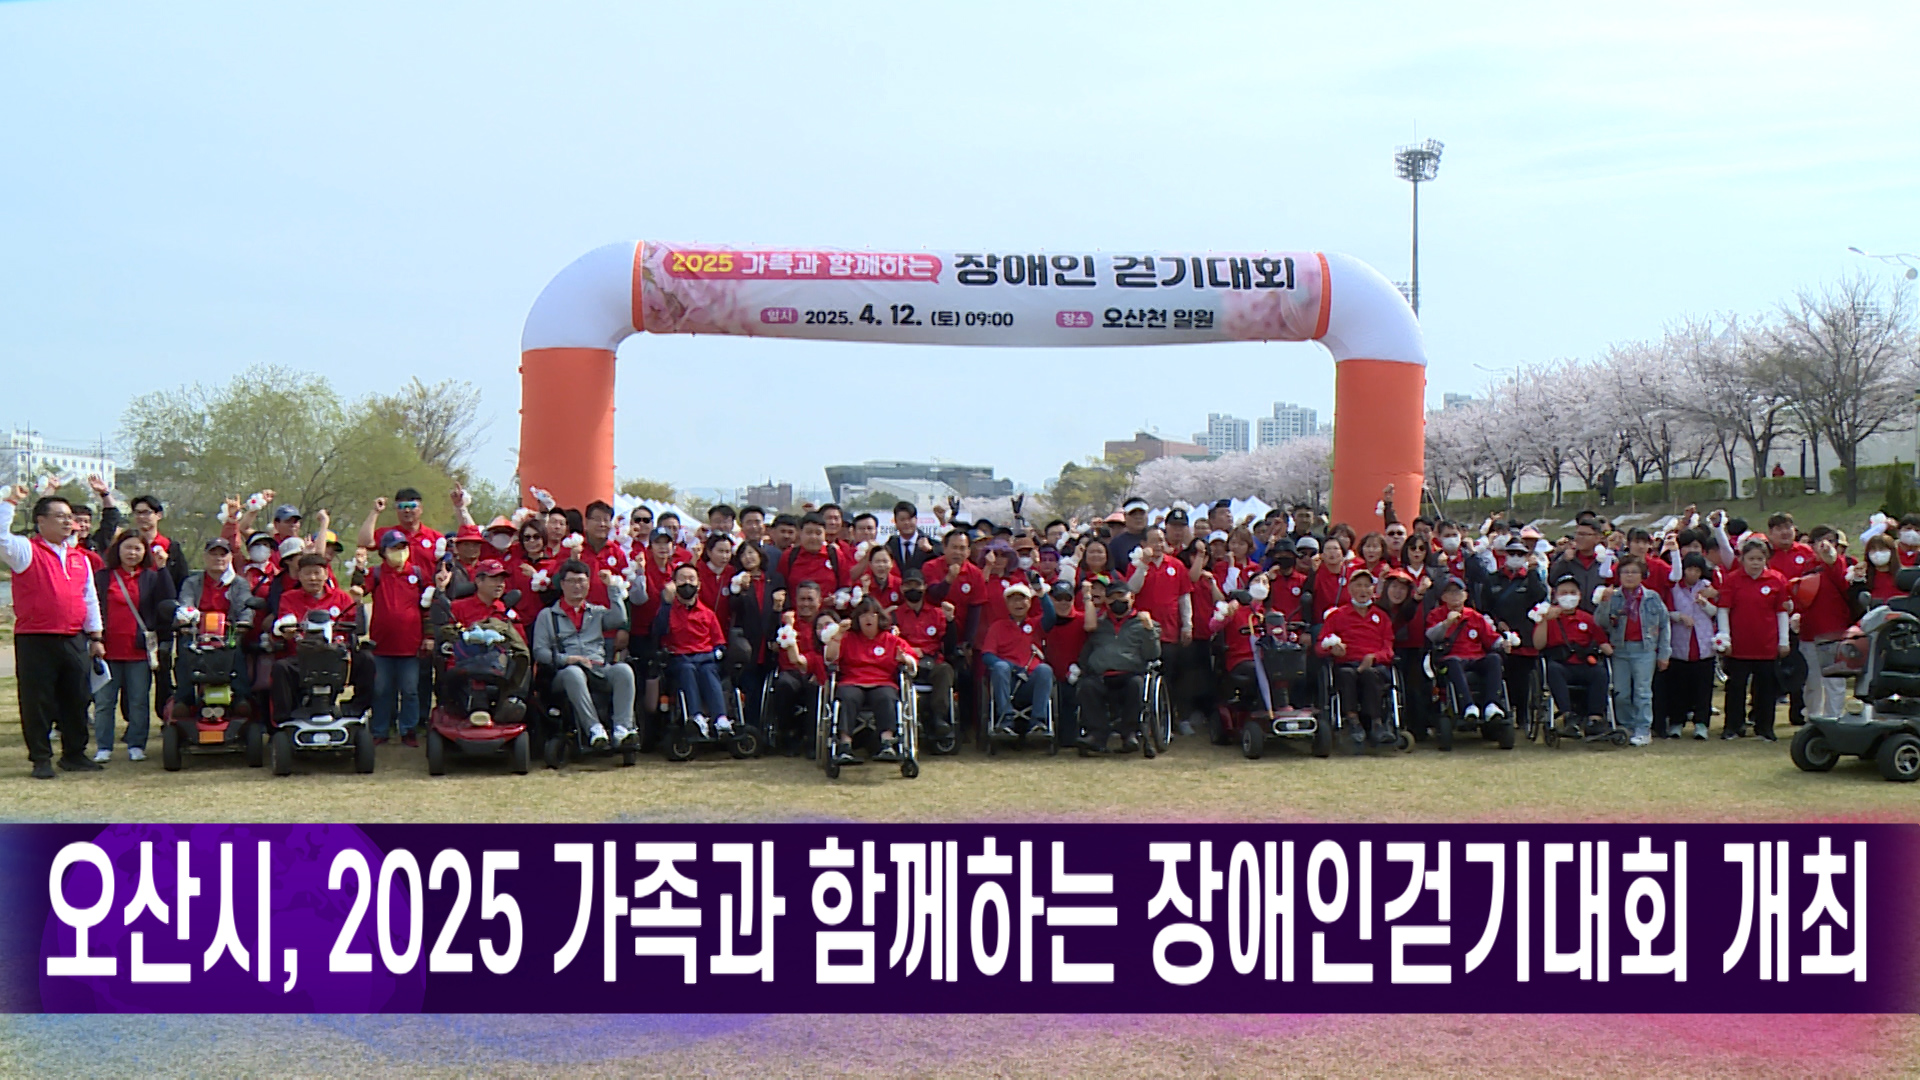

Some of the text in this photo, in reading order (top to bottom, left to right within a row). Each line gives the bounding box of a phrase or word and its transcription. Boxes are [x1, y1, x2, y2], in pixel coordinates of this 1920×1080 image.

[671, 253, 934, 277] 2025 가족과 함께하는
[954, 253, 1295, 290] 장애인 걷기대회
[766, 310, 794, 322] 일시
[804, 303, 1014, 326] 2025. 4. 12. (토) 09:00
[1062, 312, 1090, 327] 장소
[1102, 307, 1214, 329] 오산천 일원
